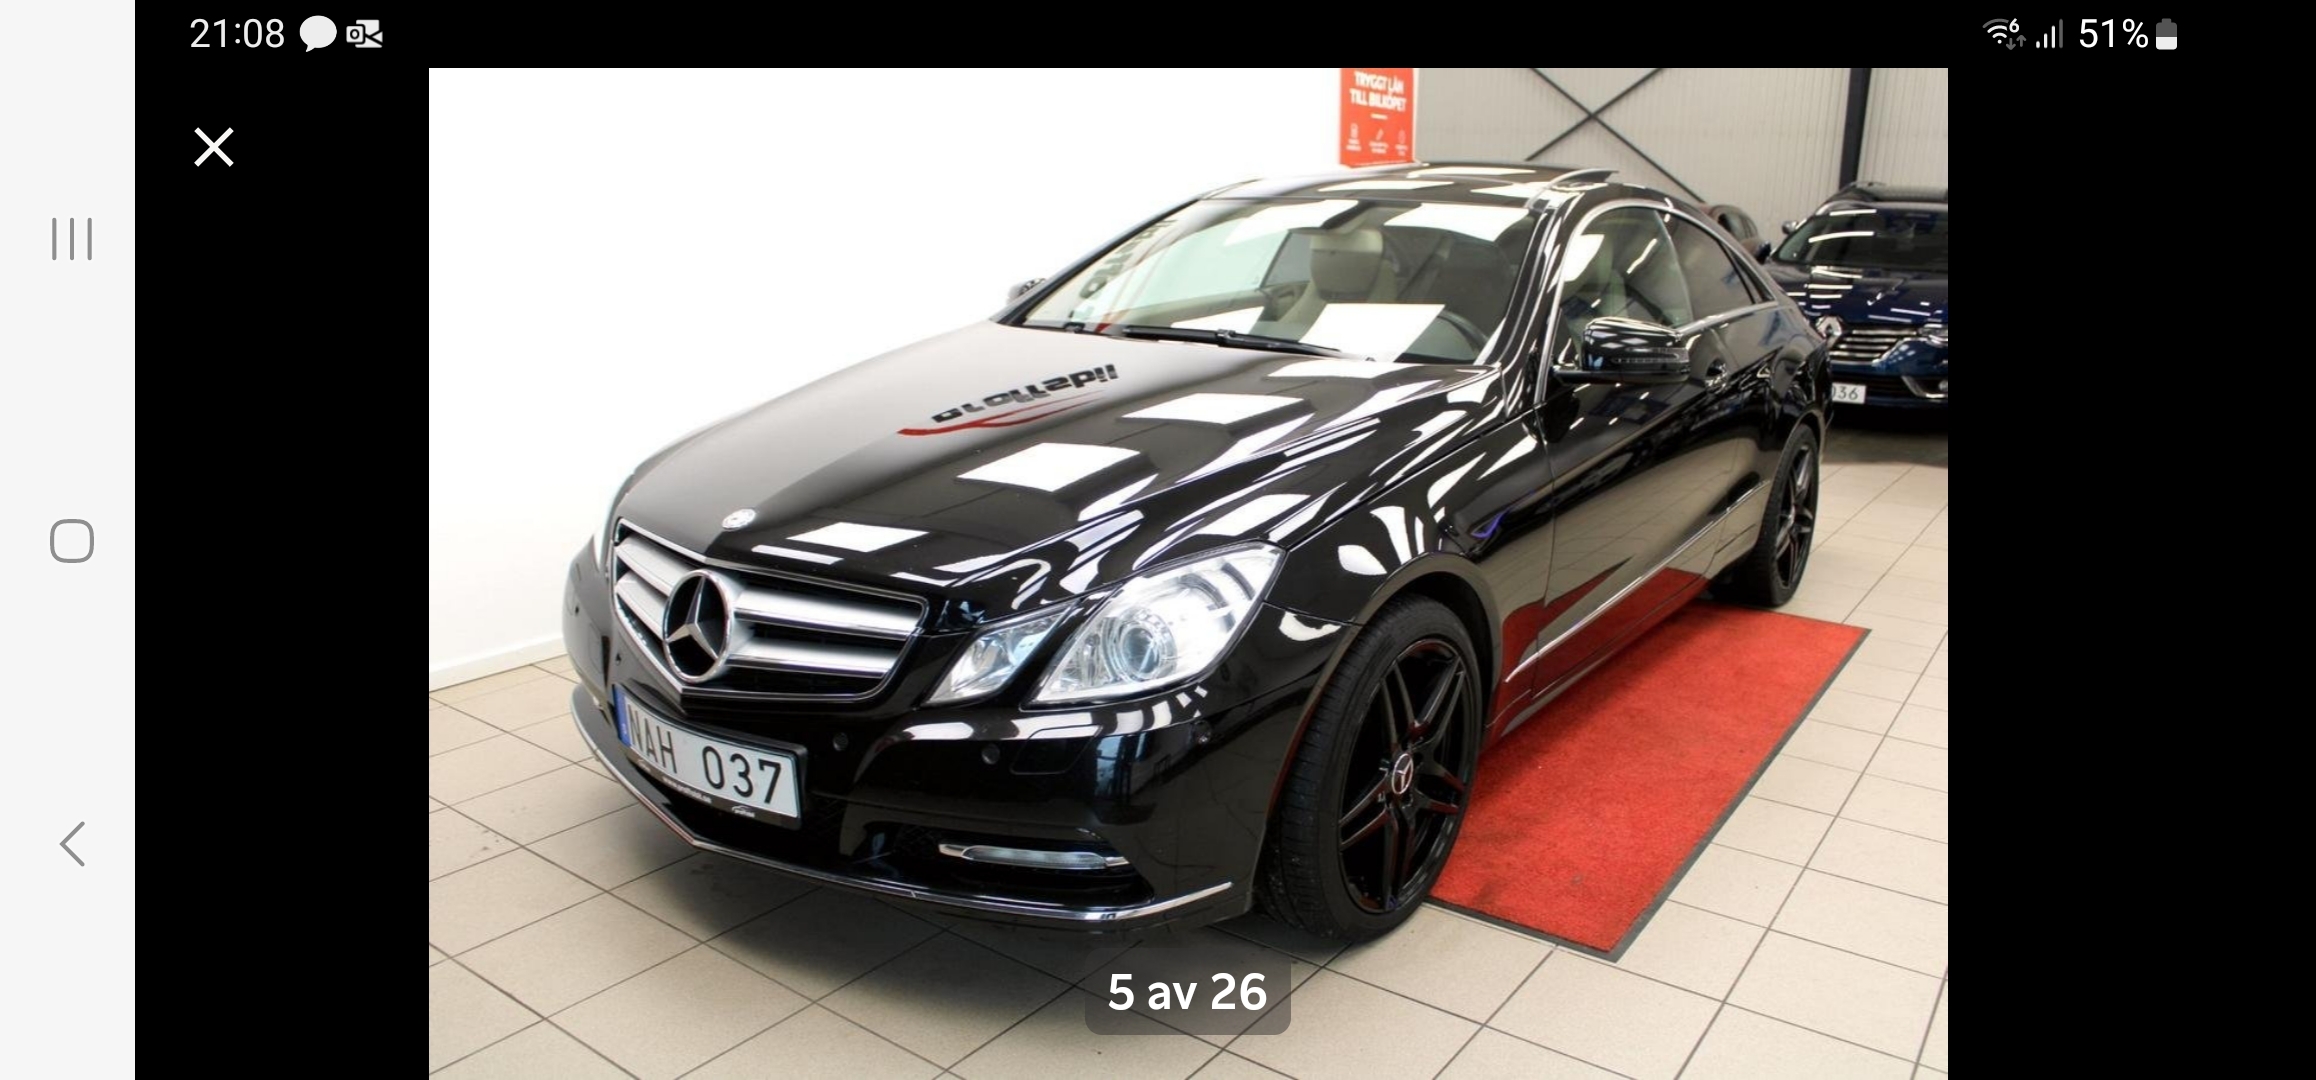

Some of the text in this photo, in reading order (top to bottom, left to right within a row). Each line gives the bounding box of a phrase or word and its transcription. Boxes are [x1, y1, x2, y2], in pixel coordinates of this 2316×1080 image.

[1349, 88, 1368, 106] TILL
[628, 704, 677, 774] NAH
[702, 746, 782, 804] 037
